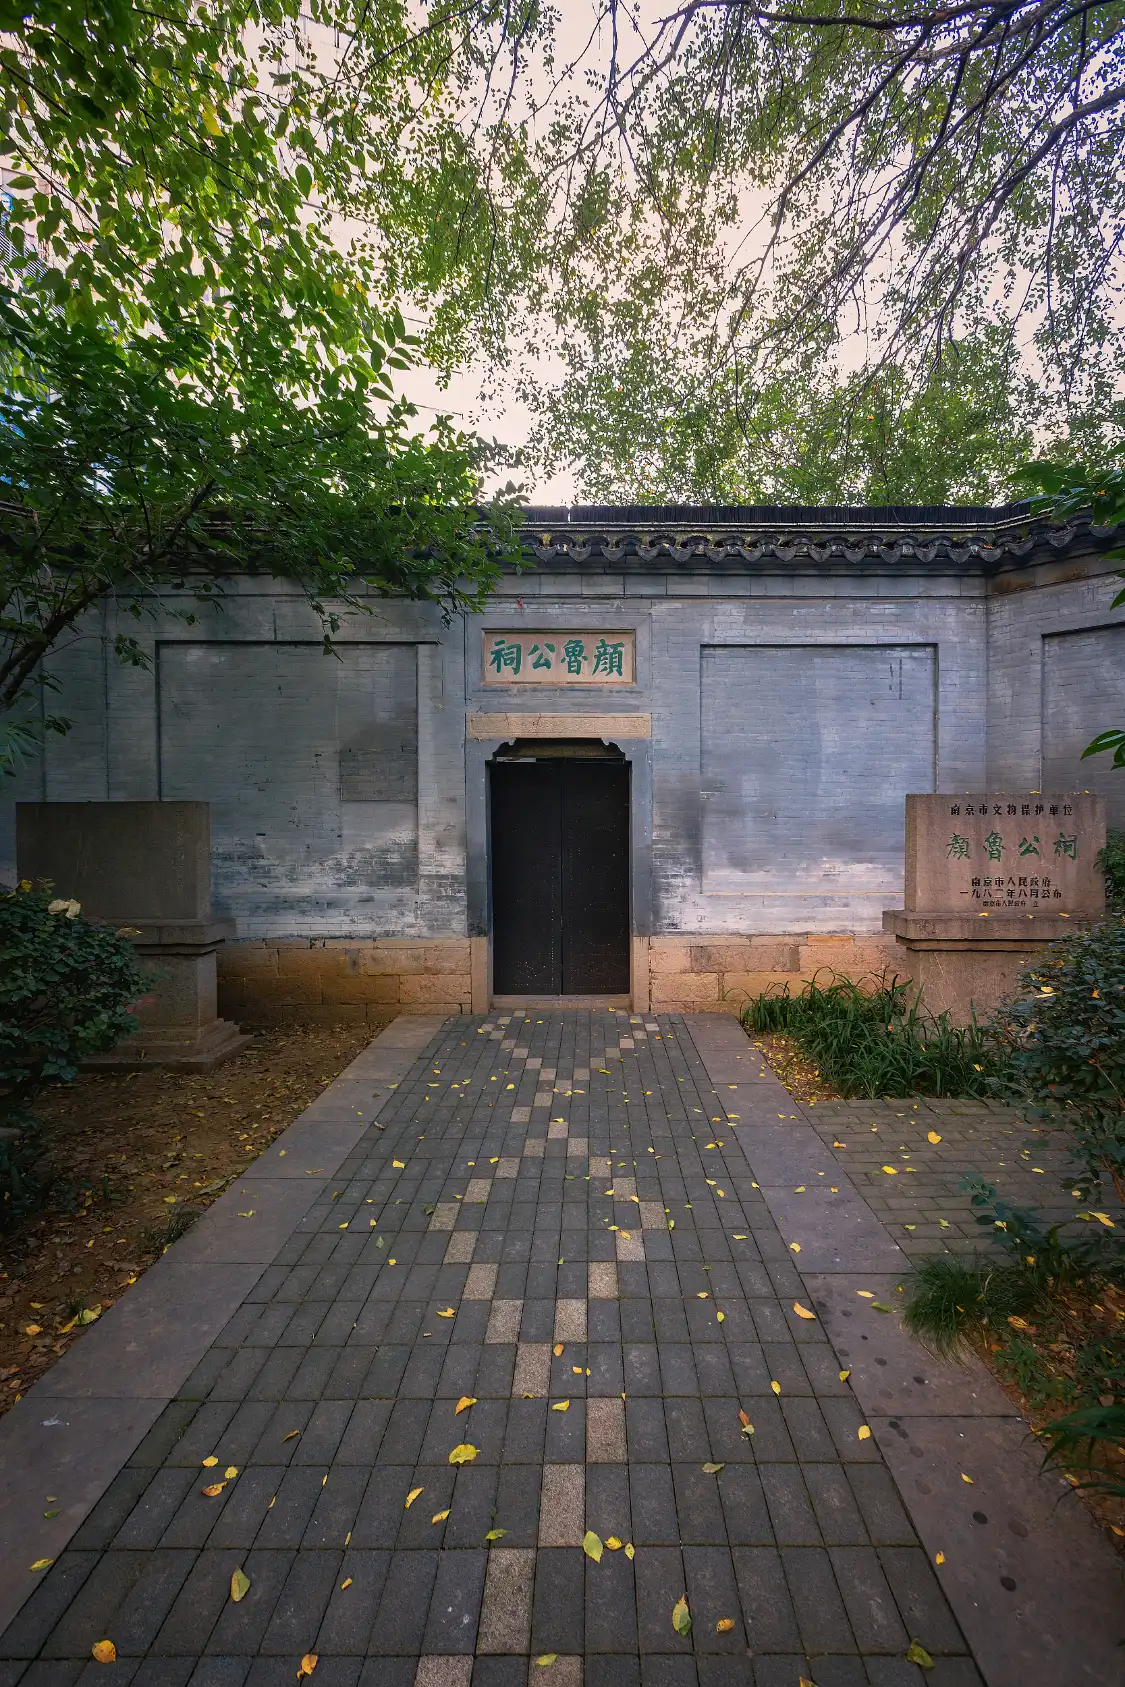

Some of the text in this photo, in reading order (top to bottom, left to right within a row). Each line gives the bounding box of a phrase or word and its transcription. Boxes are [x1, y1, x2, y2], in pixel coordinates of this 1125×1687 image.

[950, 803, 1073, 816] 南京市文物保护单位
[971, 876, 1052, 887] 南京市人民政府
[959, 888, 1062, 899] 一九八二年八月公布
